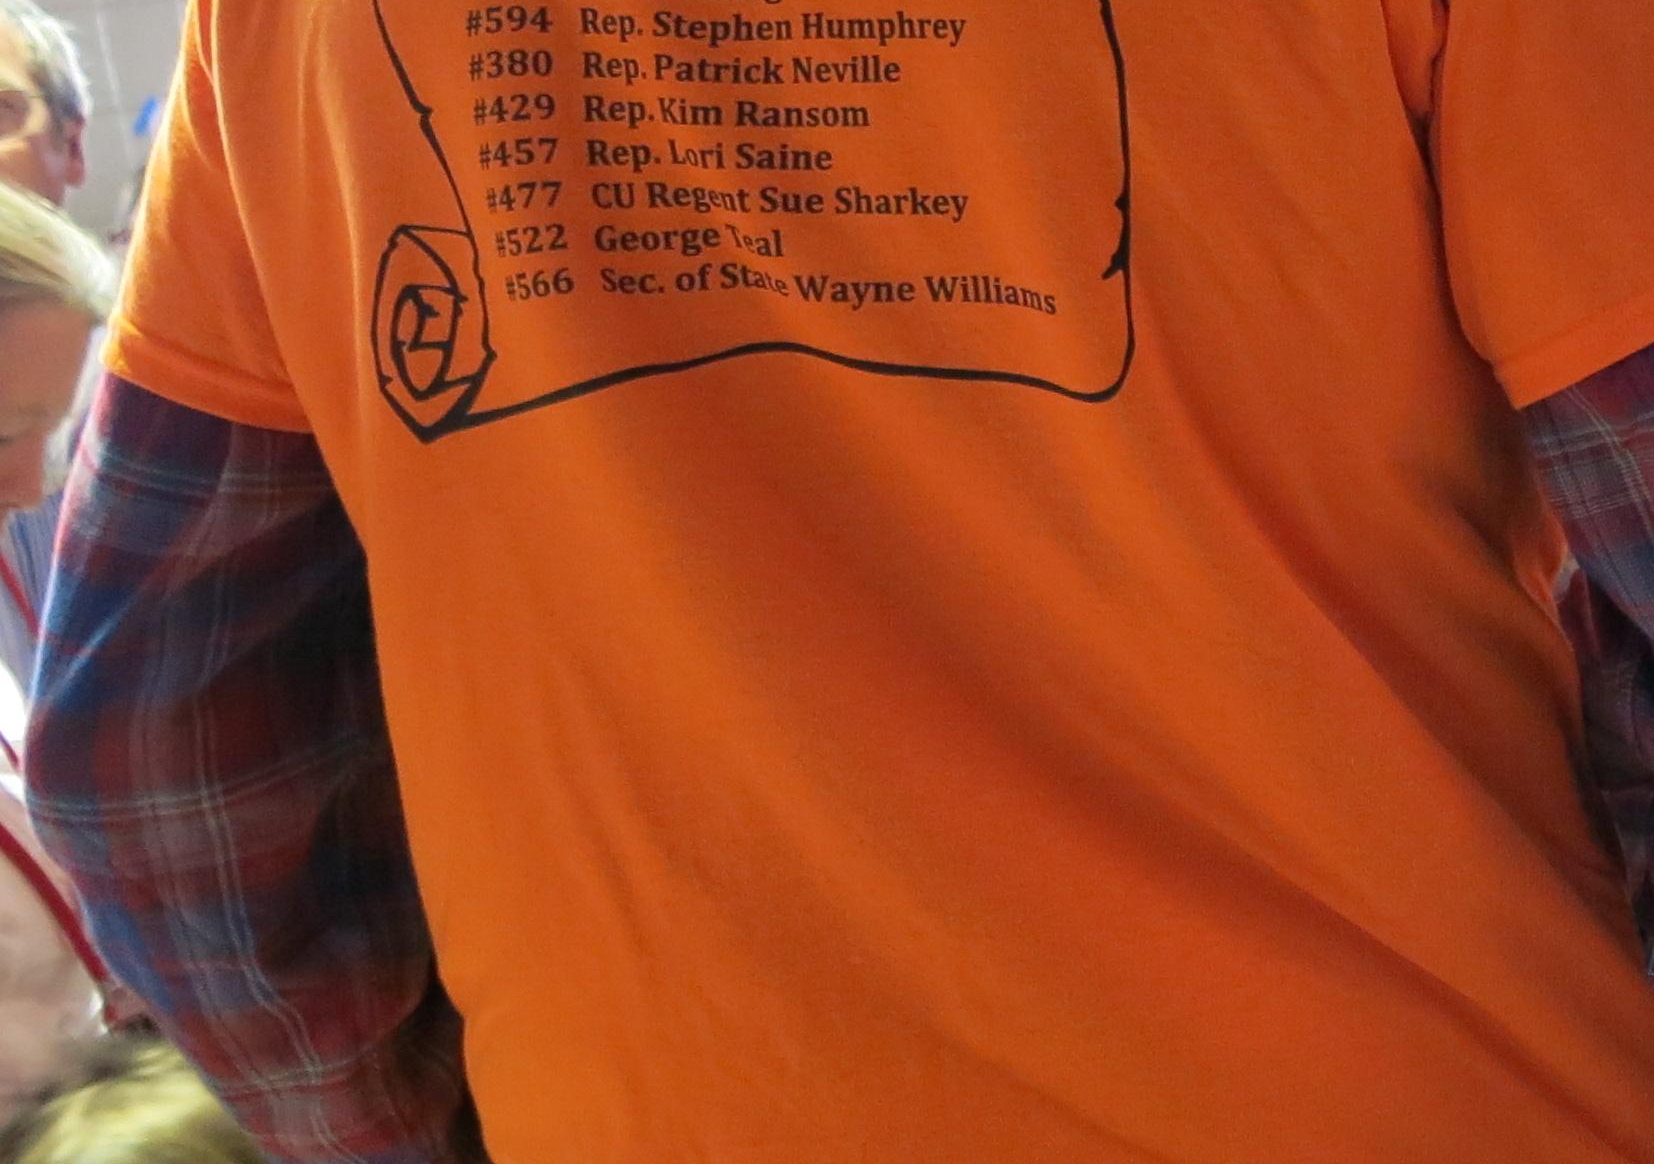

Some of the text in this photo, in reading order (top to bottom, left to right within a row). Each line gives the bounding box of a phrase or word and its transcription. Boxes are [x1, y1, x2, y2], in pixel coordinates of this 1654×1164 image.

[465, 7, 966, 48] #594 Rep. Stephen Humphrey
[468, 50, 901, 86] #380 Rep. Patrick Neville
[473, 94, 870, 128] #429 Rep. Kim Ransom
[478, 138, 833, 172] #457 Rep. Lori Saine
[486, 182, 969, 222] #477 CU Regent Sue Sharkey
[496, 224, 784, 257] #522 George Teal
[506, 264, 1056, 315] #566 Sec. of State Wayne Williams
